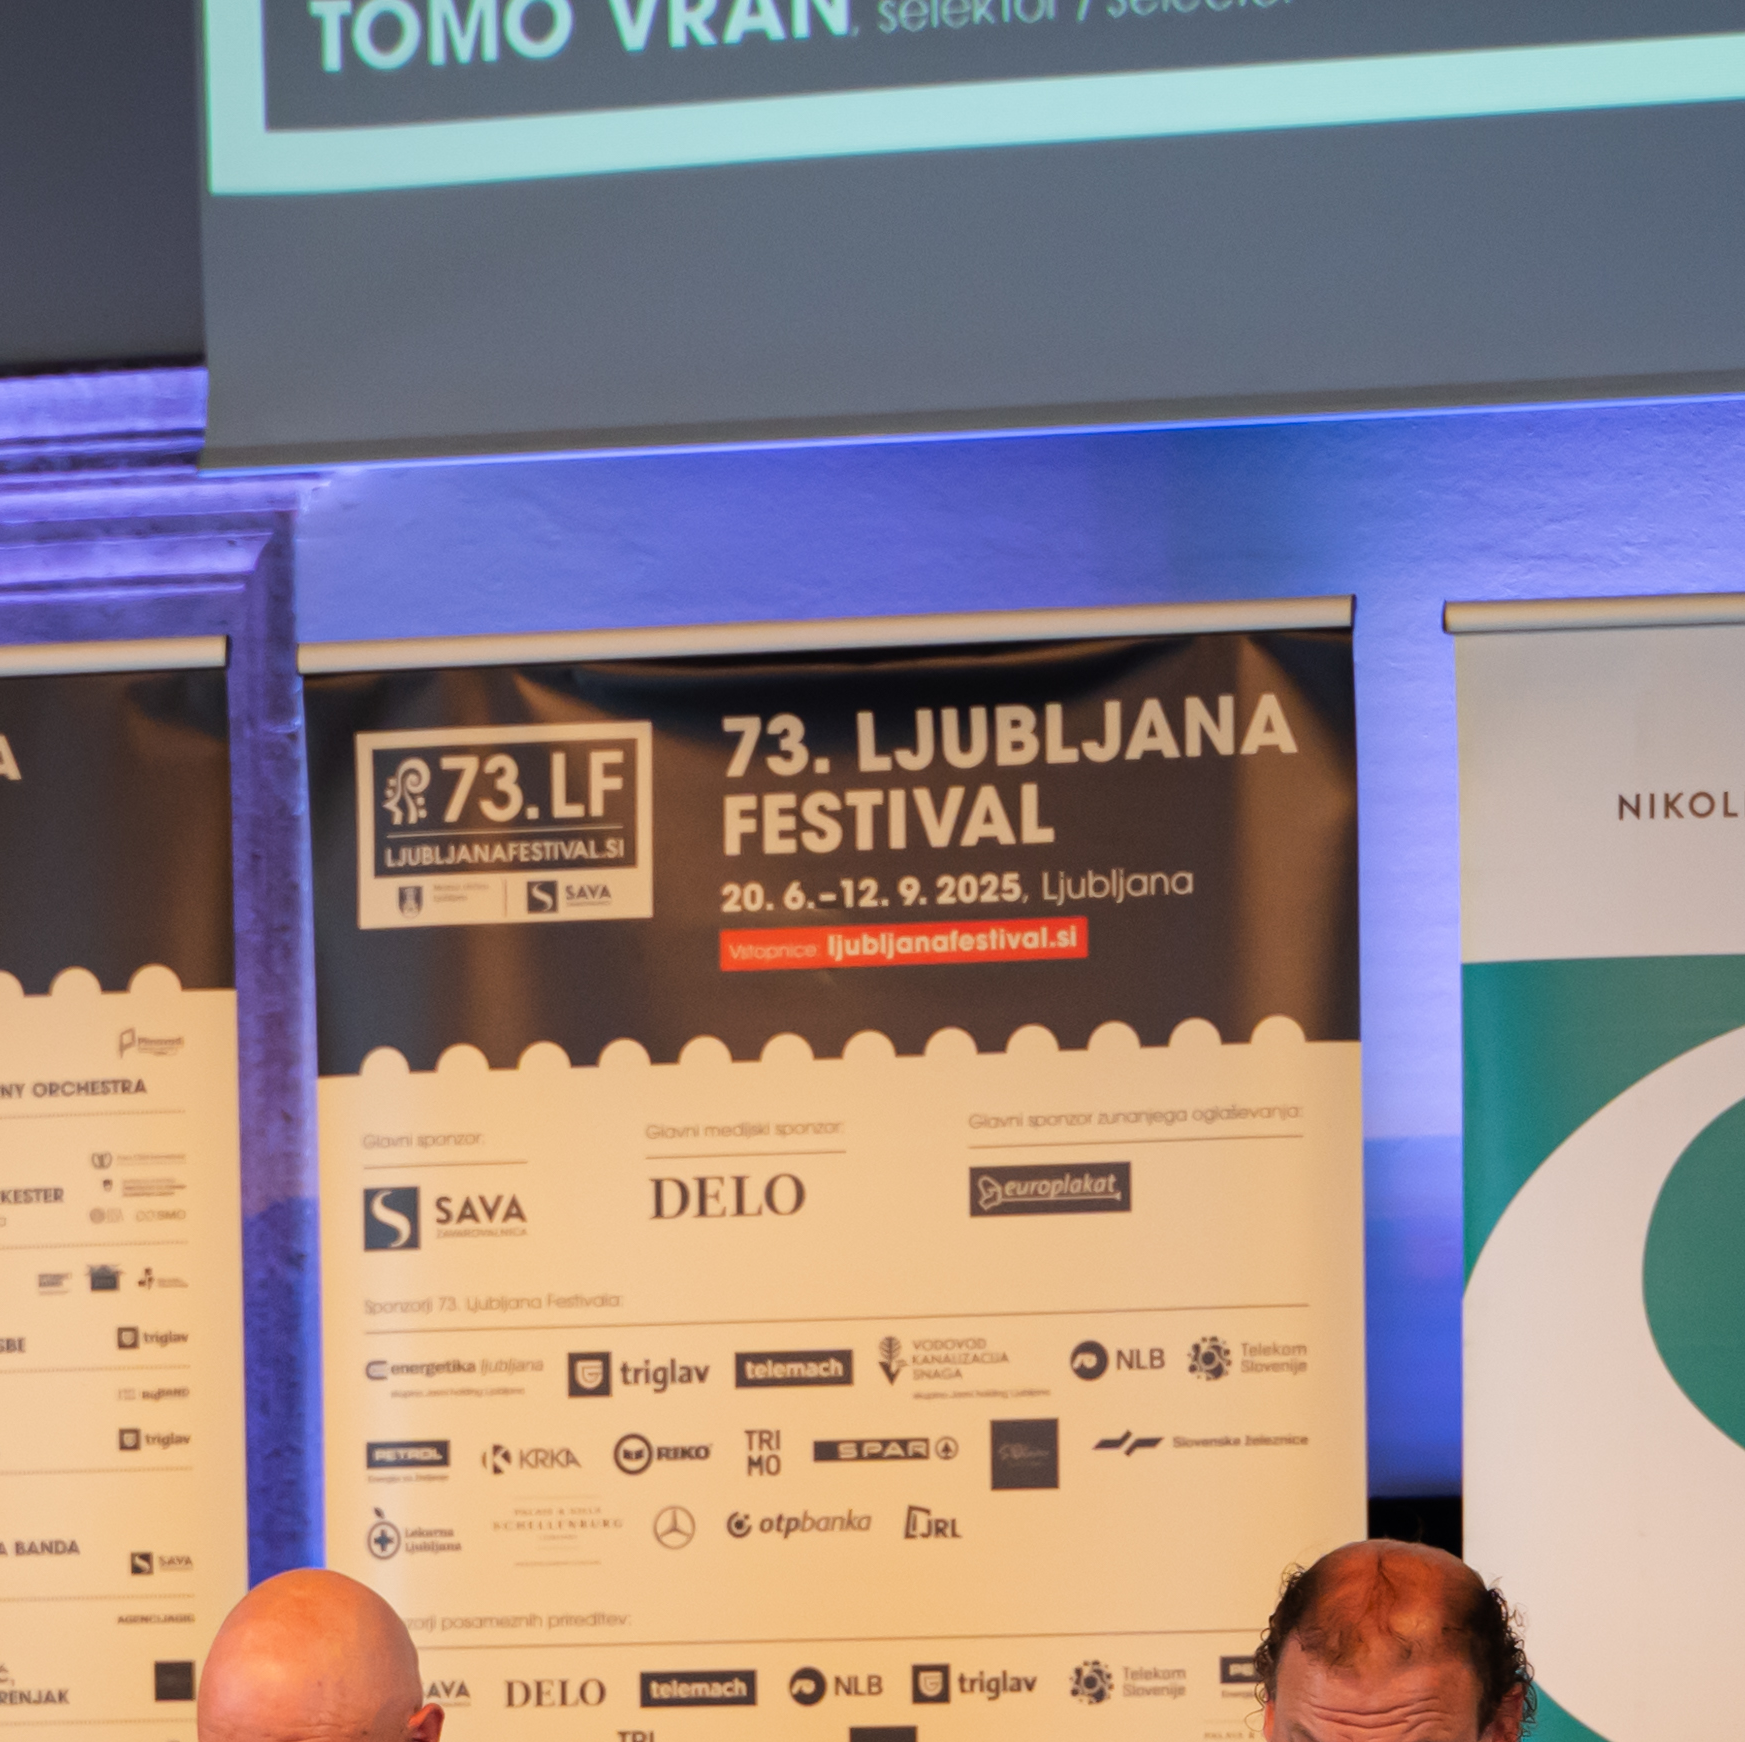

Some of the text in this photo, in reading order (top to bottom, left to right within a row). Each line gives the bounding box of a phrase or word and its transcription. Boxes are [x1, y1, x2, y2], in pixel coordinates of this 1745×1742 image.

[309, 0, 573, 72] TOMO
[722, 694, 1297, 777] 73. LJUBLJANA
[723, 783, 1054, 855] FESTIVAL
[385, 838, 624, 868] LJUBLJANAFESTIVAL.SI
[566, 884, 611, 901] SAVA
[721, 883, 772, 912] 20.
[899, 877, 927, 906] 9.
[1043, 868, 1193, 906] Ljubljana
[828, 925, 1078, 961] ljubljanafestival.si
[33, 1079, 146, 1098] ORCHESTRA
[649, 1174, 806, 1219] DELO
[1004, 1174, 1116, 1198] europlakat
[436, 1193, 528, 1225] SAVA
[144, 1330, 189, 1346] triglav
[913, 1338, 986, 1350] VODOVOD
[912, 1353, 1009, 1365] KANALIZACIJA
[1116, 1348, 1165, 1371] NLB
[1242, 1342, 1307, 1357] Telekom
[390, 1357, 543, 1377] energetika ljubljana
[620, 1358, 709, 1393] triglav
[744, 1359, 843, 1381] telemach
[913, 1367, 962, 1379] SNAGA
[1242, 1358, 1307, 1375] Slovenije
[146, 1432, 190, 1447] triglav
[745, 1430, 780, 1451] TRI
[837, 1441, 927, 1459] SPAR
[519, 1448, 581, 1469] KRKA
[657, 1445, 712, 1461] RIKO
[747, 1455, 781, 1476] MO
[759, 1509, 871, 1540] otpbanka
[15, 1538, 79, 1556] BANDA
[958, 1669, 1037, 1700] triglav
[1123, 1666, 1185, 1682] Telekom
[505, 1679, 606, 1707] DELO
[650, 1680, 746, 1700] telemach
[834, 1674, 883, 1696] NLB
[1123, 1682, 1185, 1698] Slovenije
